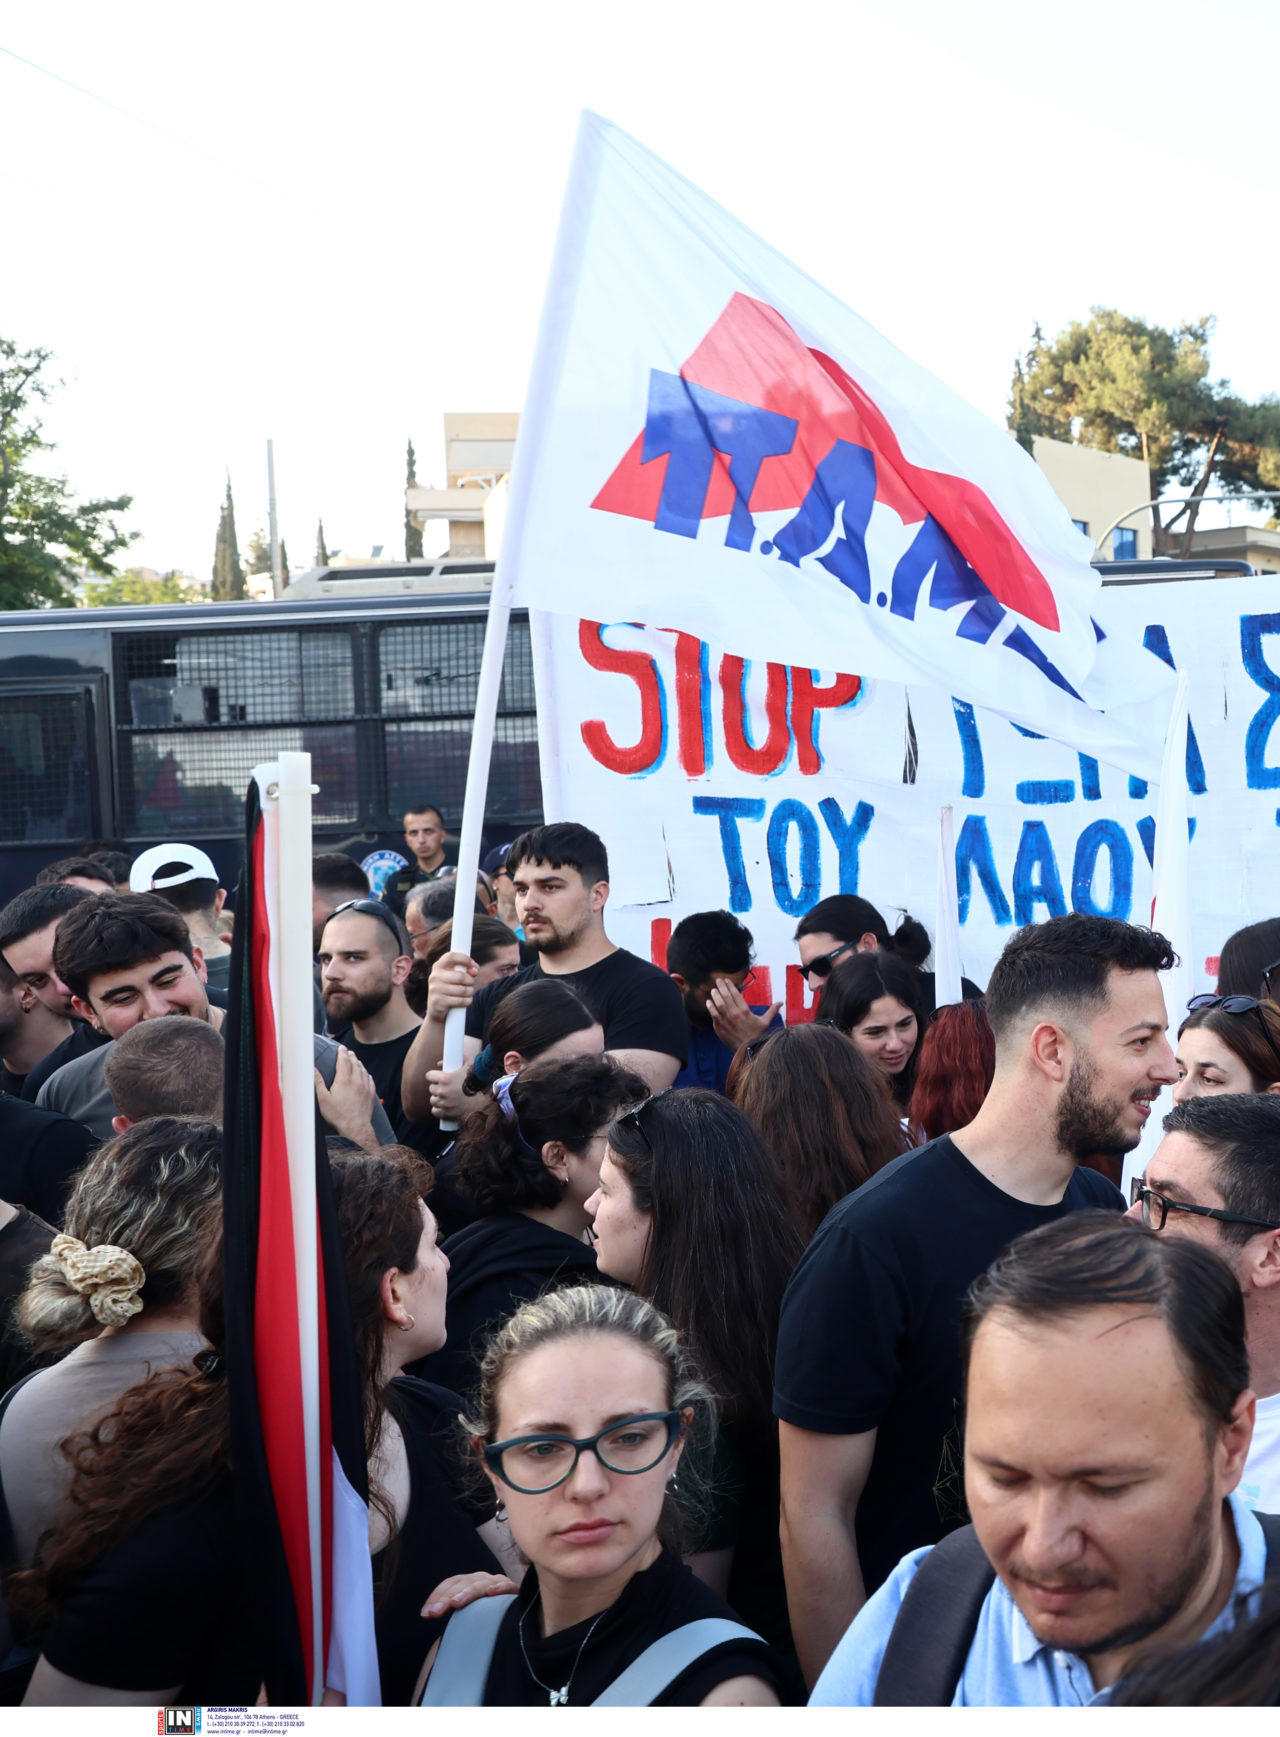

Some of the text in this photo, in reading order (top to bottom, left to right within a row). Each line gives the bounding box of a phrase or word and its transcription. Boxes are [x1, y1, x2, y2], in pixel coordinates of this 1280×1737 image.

[579, 618, 871, 782] STOP
[693, 796, 875, 917] ΤΟΥ
[957, 814, 1197, 927] ΛΑΟ
